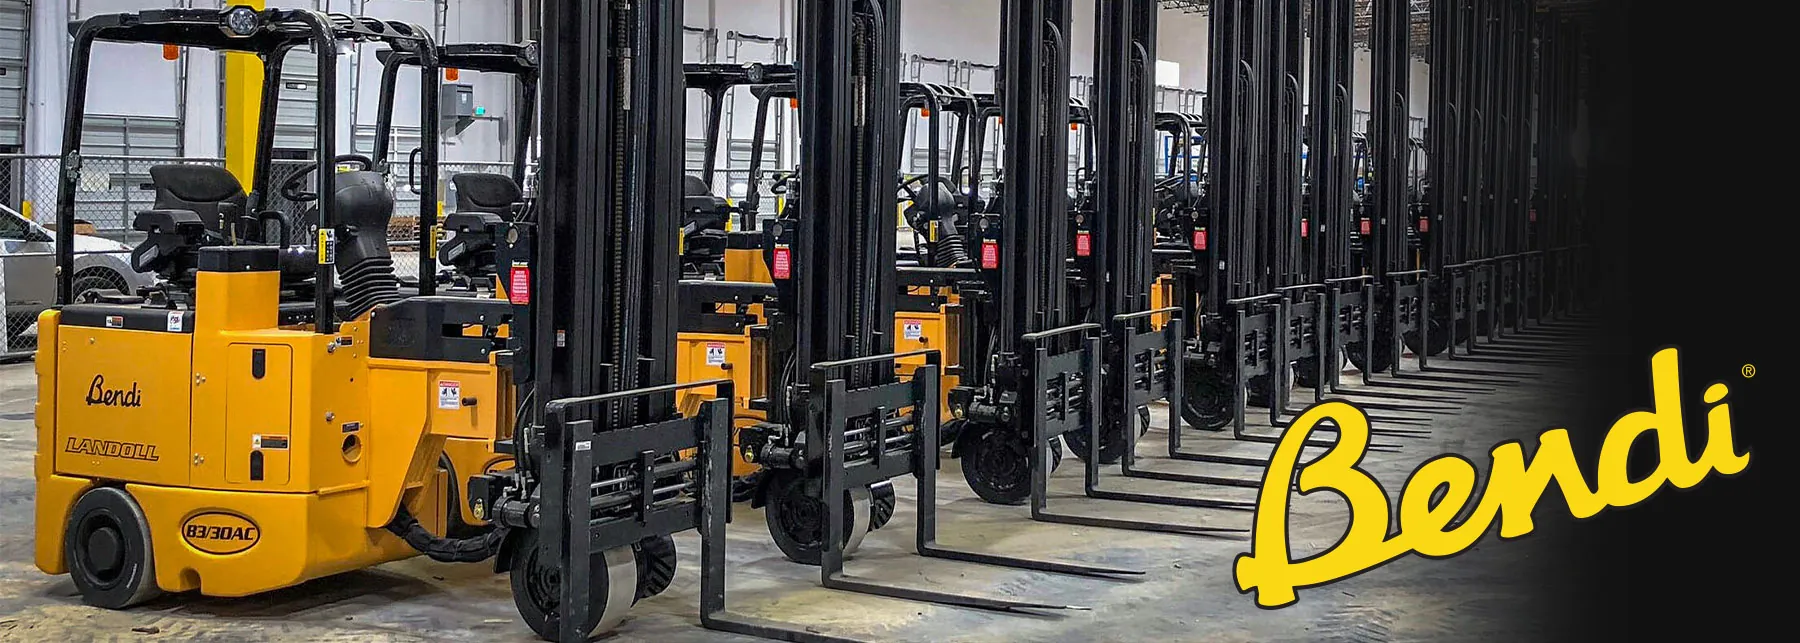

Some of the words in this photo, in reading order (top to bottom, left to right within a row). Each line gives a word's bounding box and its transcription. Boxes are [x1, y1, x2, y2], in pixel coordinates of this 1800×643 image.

[86, 374, 142, 407] Bendi
[65, 436, 160, 462] LANDOLL
[186, 524, 256, 541] B3/30AC
